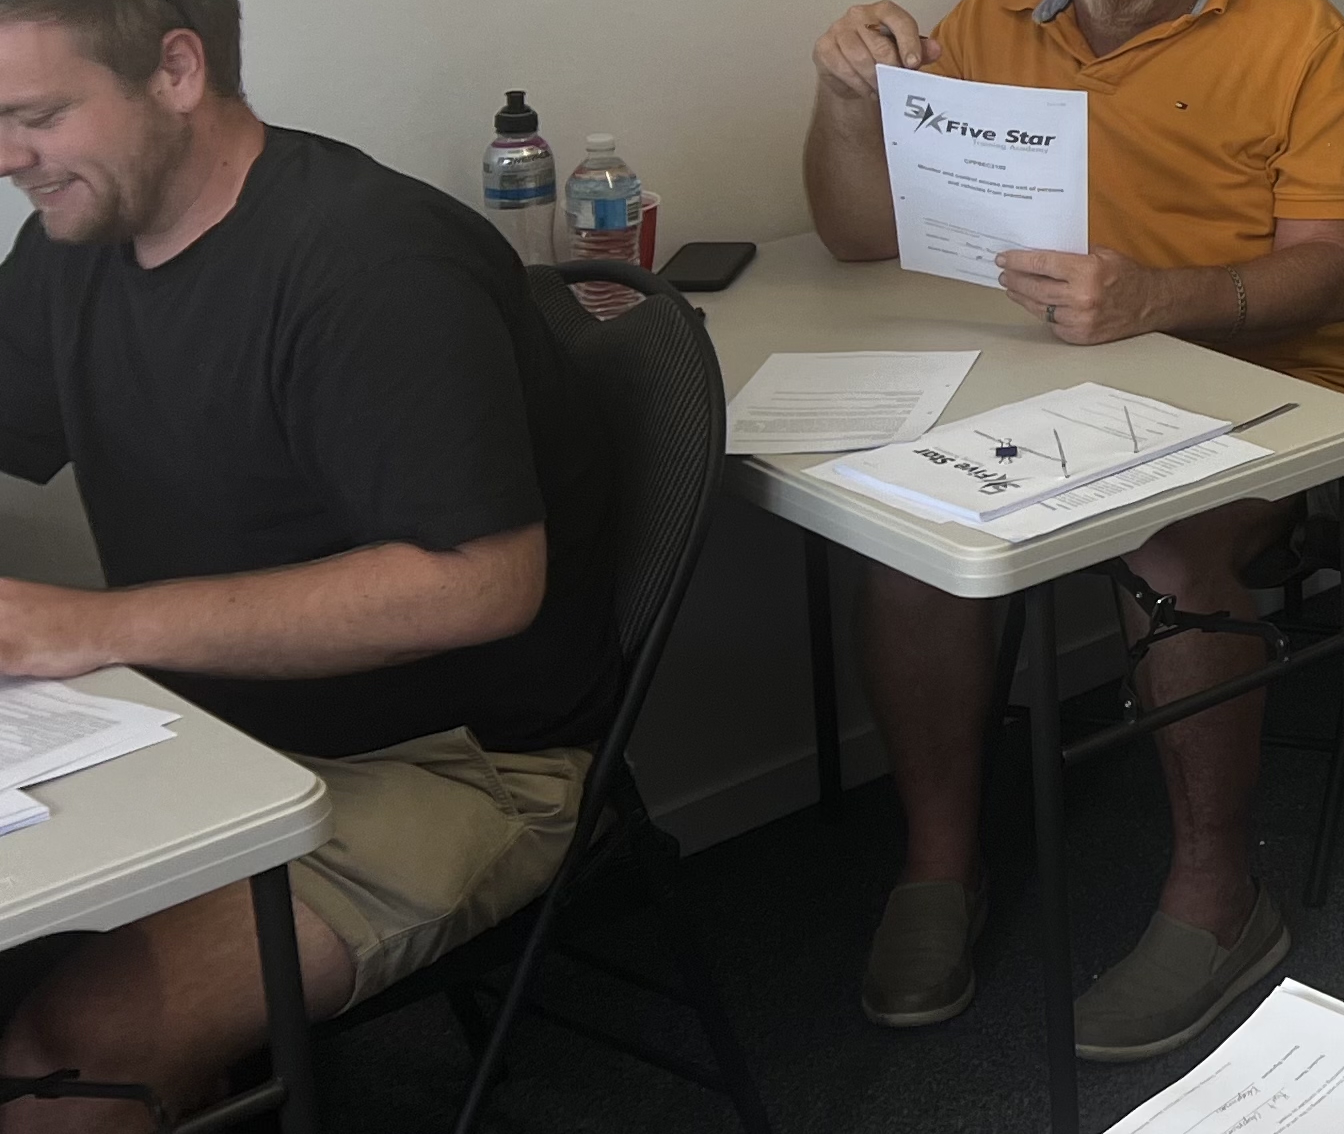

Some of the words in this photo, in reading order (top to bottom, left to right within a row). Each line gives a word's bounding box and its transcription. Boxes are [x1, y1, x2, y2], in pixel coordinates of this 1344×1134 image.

[946, 120, 997, 141] Five
[1005, 129, 1056, 147] Star
[911, 448, 956, 466] Star
